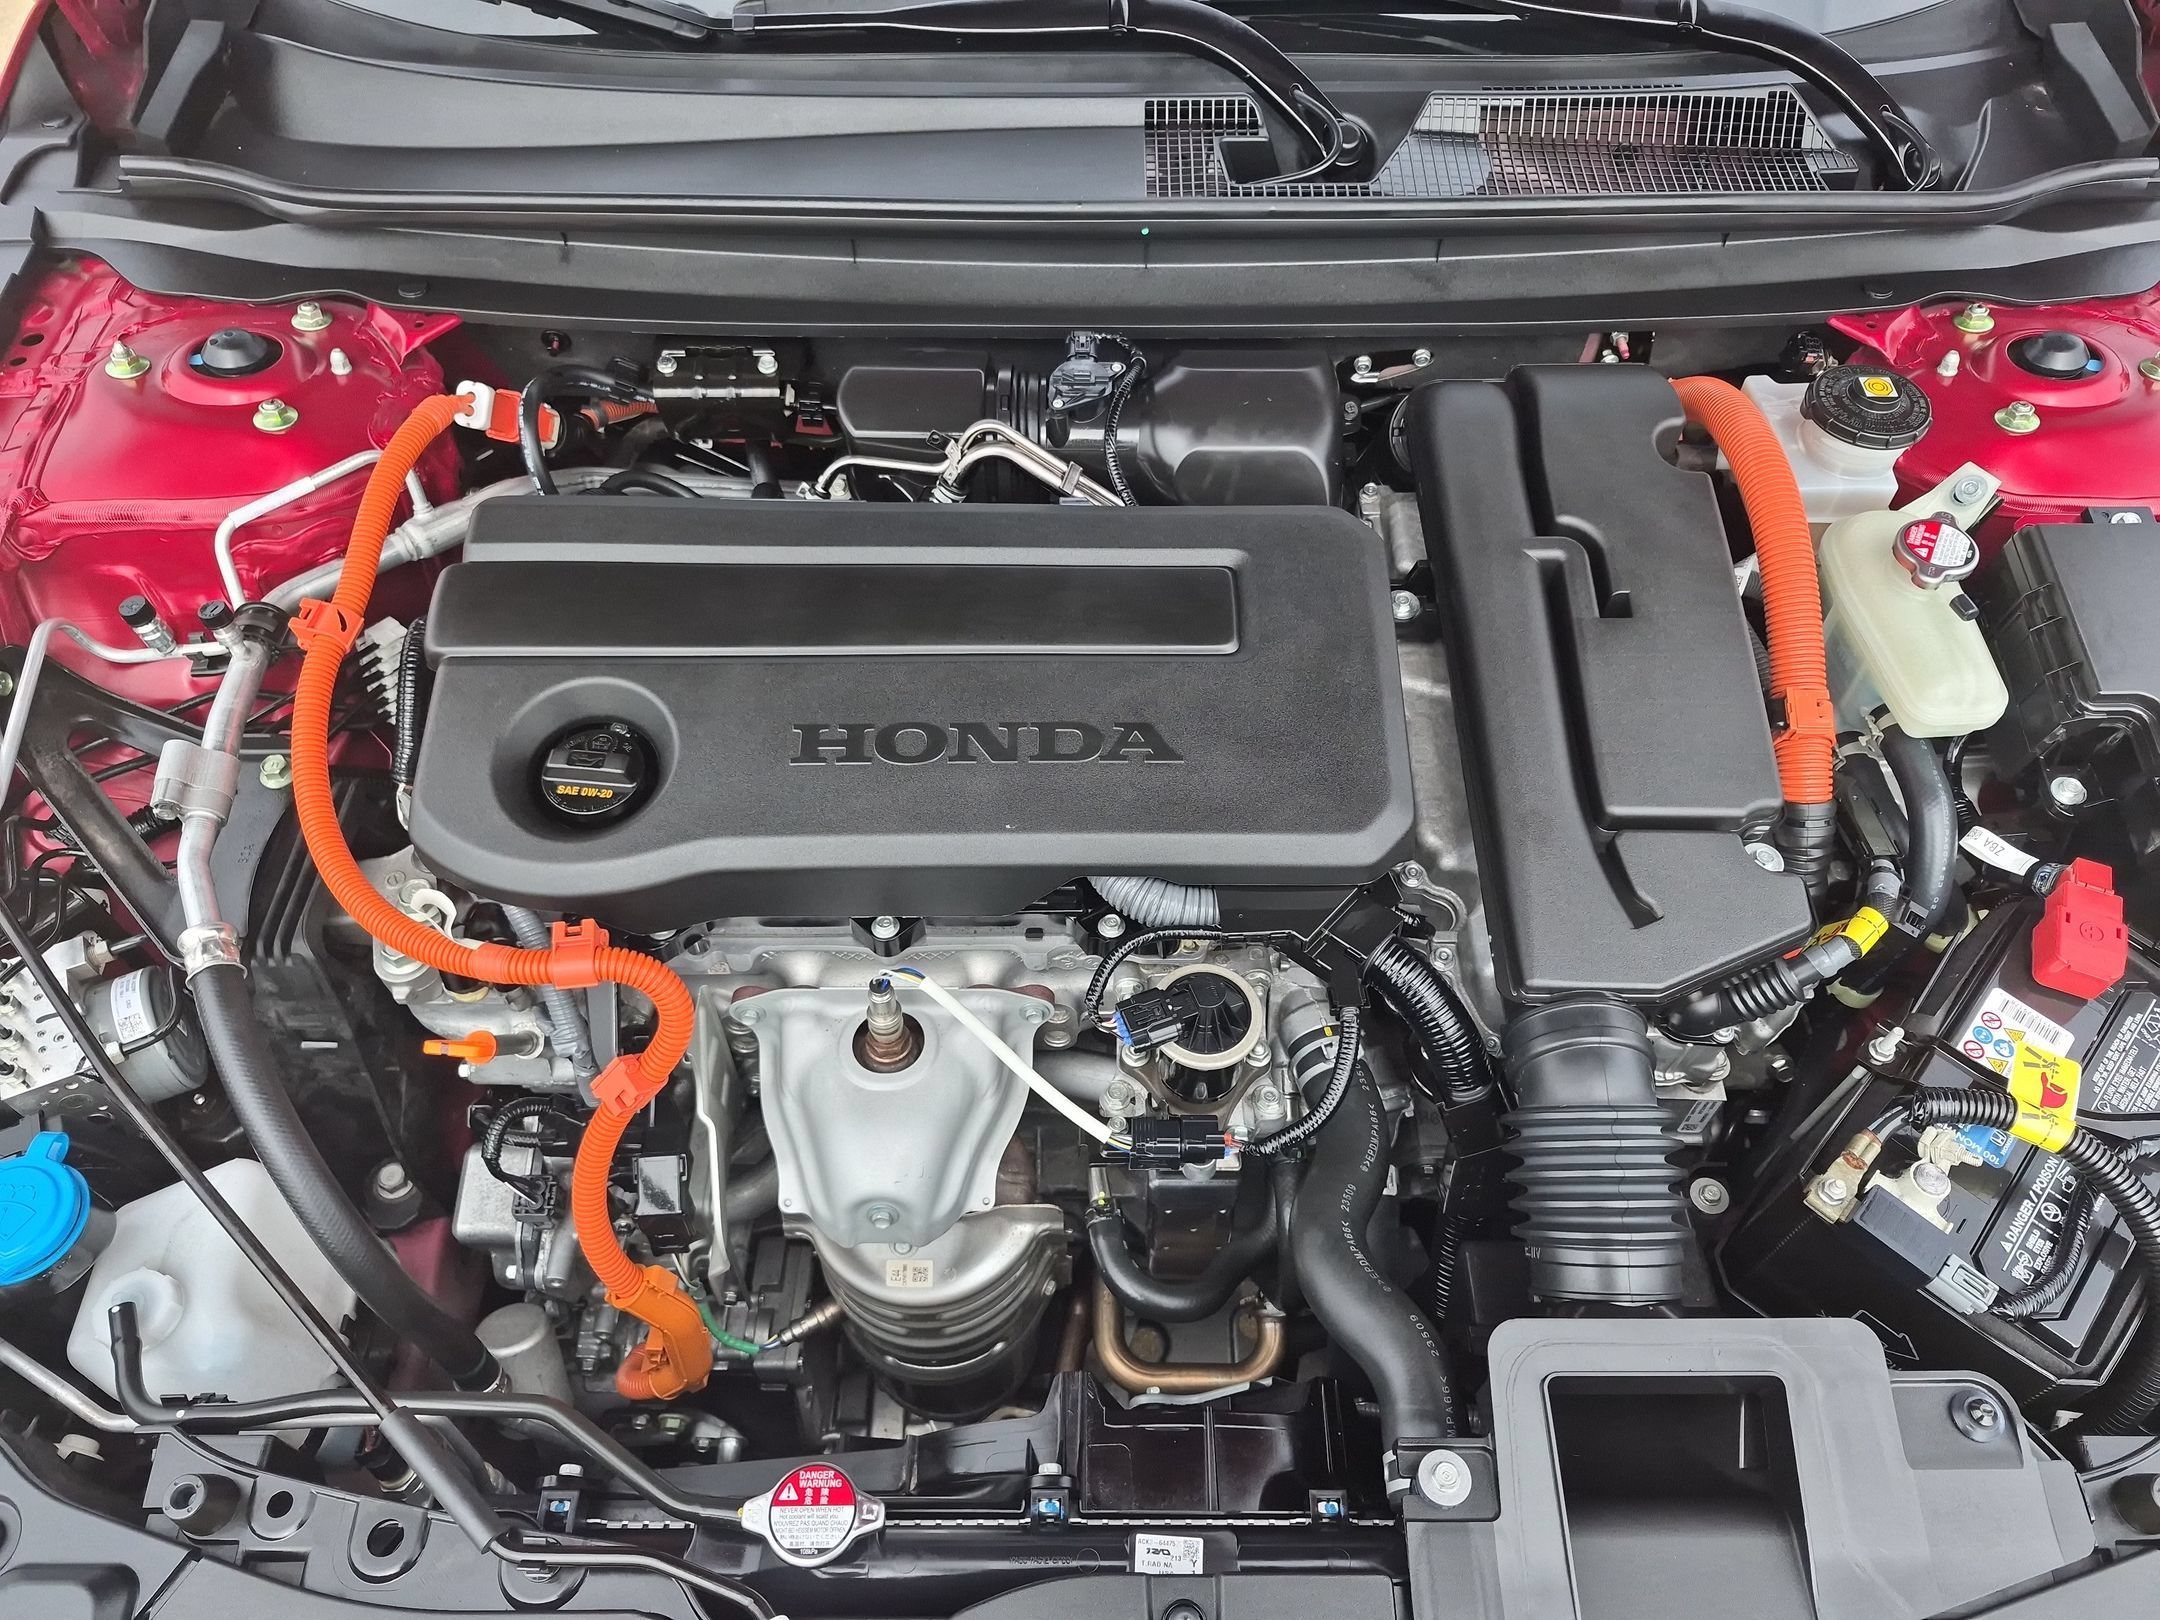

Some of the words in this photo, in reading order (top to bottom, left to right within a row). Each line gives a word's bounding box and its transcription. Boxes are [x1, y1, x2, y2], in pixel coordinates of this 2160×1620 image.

[789, 722, 1185, 765] HONDA
[556, 785, 580, 795] SAE
[580, 787, 613, 799] 0W-20
[1983, 836, 2006, 857] ZBA
[2136, 1065, 2148, 1080] FAST
[1983, 1150, 2000, 1165] 100
[2006, 1200, 2035, 1241] DANGER
[2032, 1156, 2059, 1194] POISON
[2025, 1229, 2040, 1249] SHIELD
[2033, 1240, 2054, 1270] EXPLOSIVE
[1410, 1314, 1440, 1357] 23509
[799, 1470, 835, 1479] DANGER
[799, 1479, 843, 1488] WARNUNG
[1191, 1559, 1197, 1568] Y
